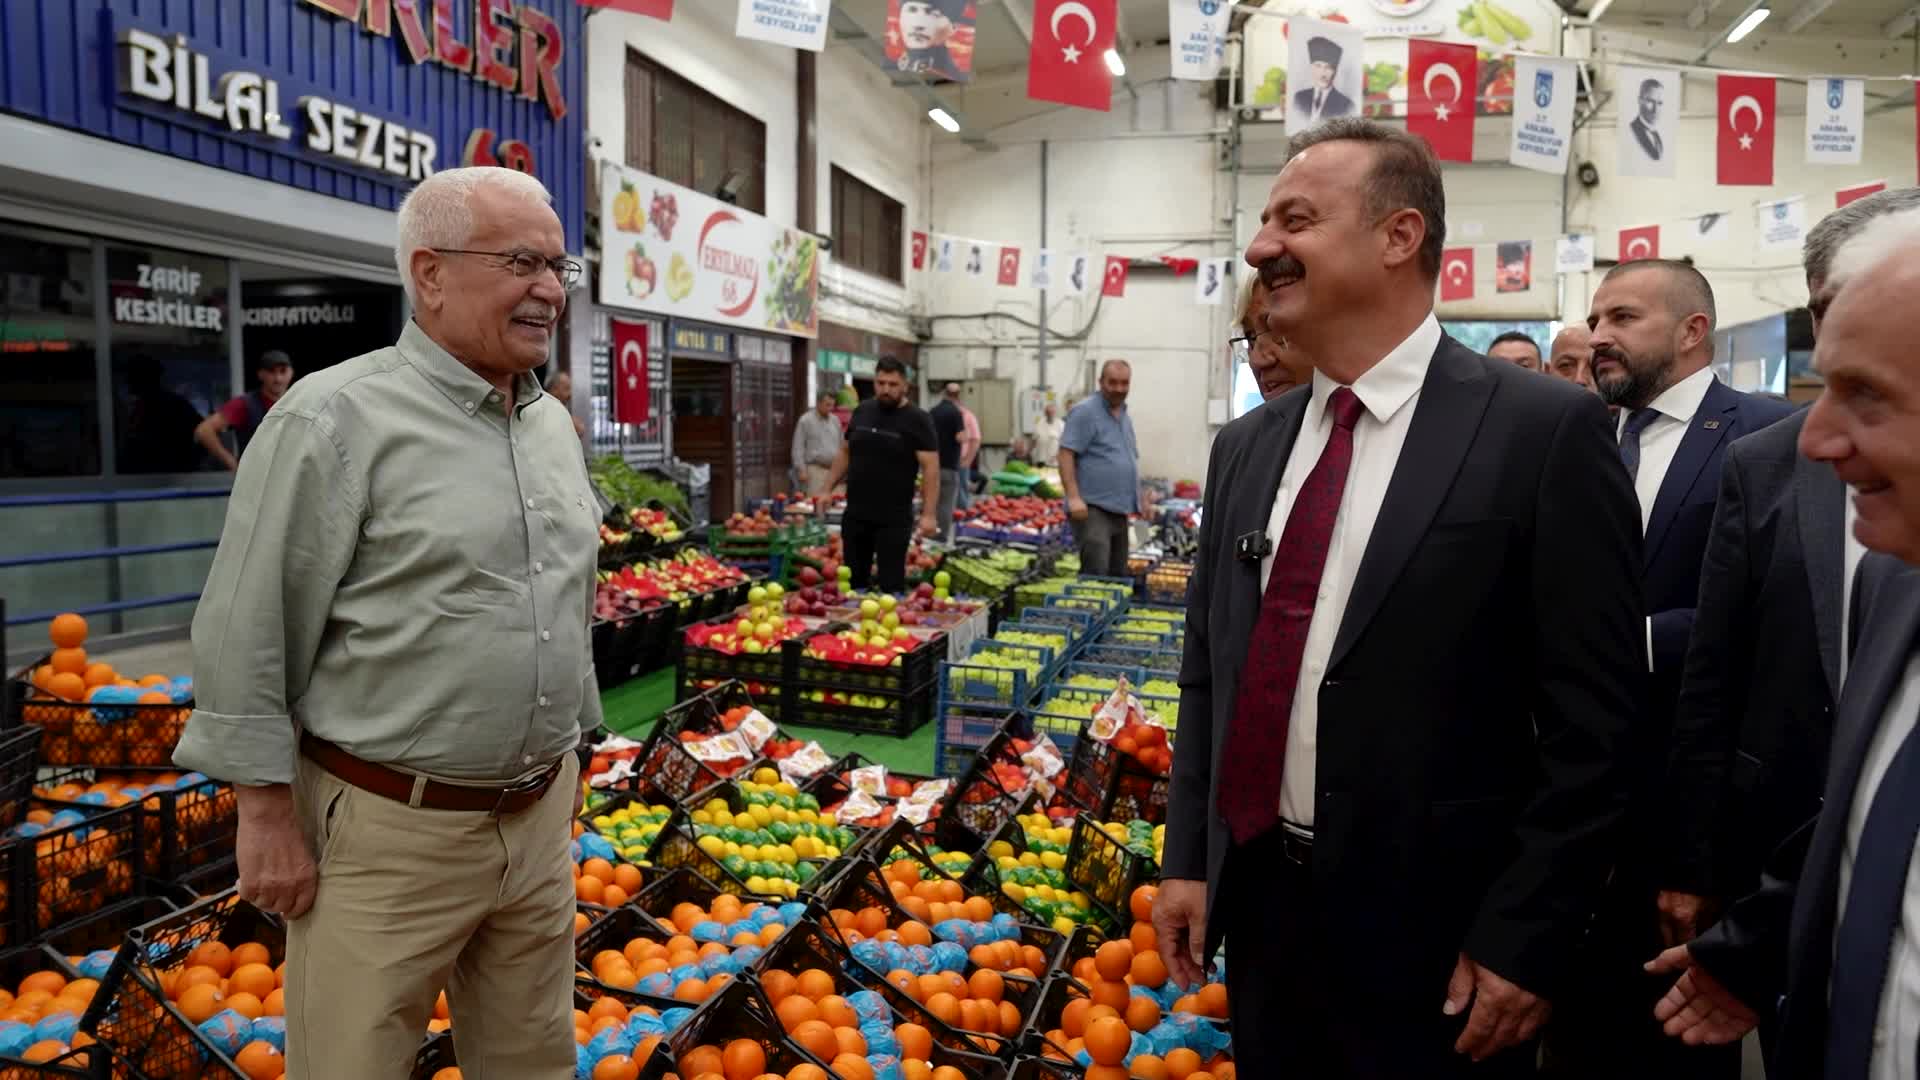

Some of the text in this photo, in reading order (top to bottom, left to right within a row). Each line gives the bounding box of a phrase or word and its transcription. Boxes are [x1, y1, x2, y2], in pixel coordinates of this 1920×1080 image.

[123, 28, 438, 181] BİLAL SEZER
[137, 263, 201, 296] ZARİF
[114, 296, 223, 332] KESİCİLER
